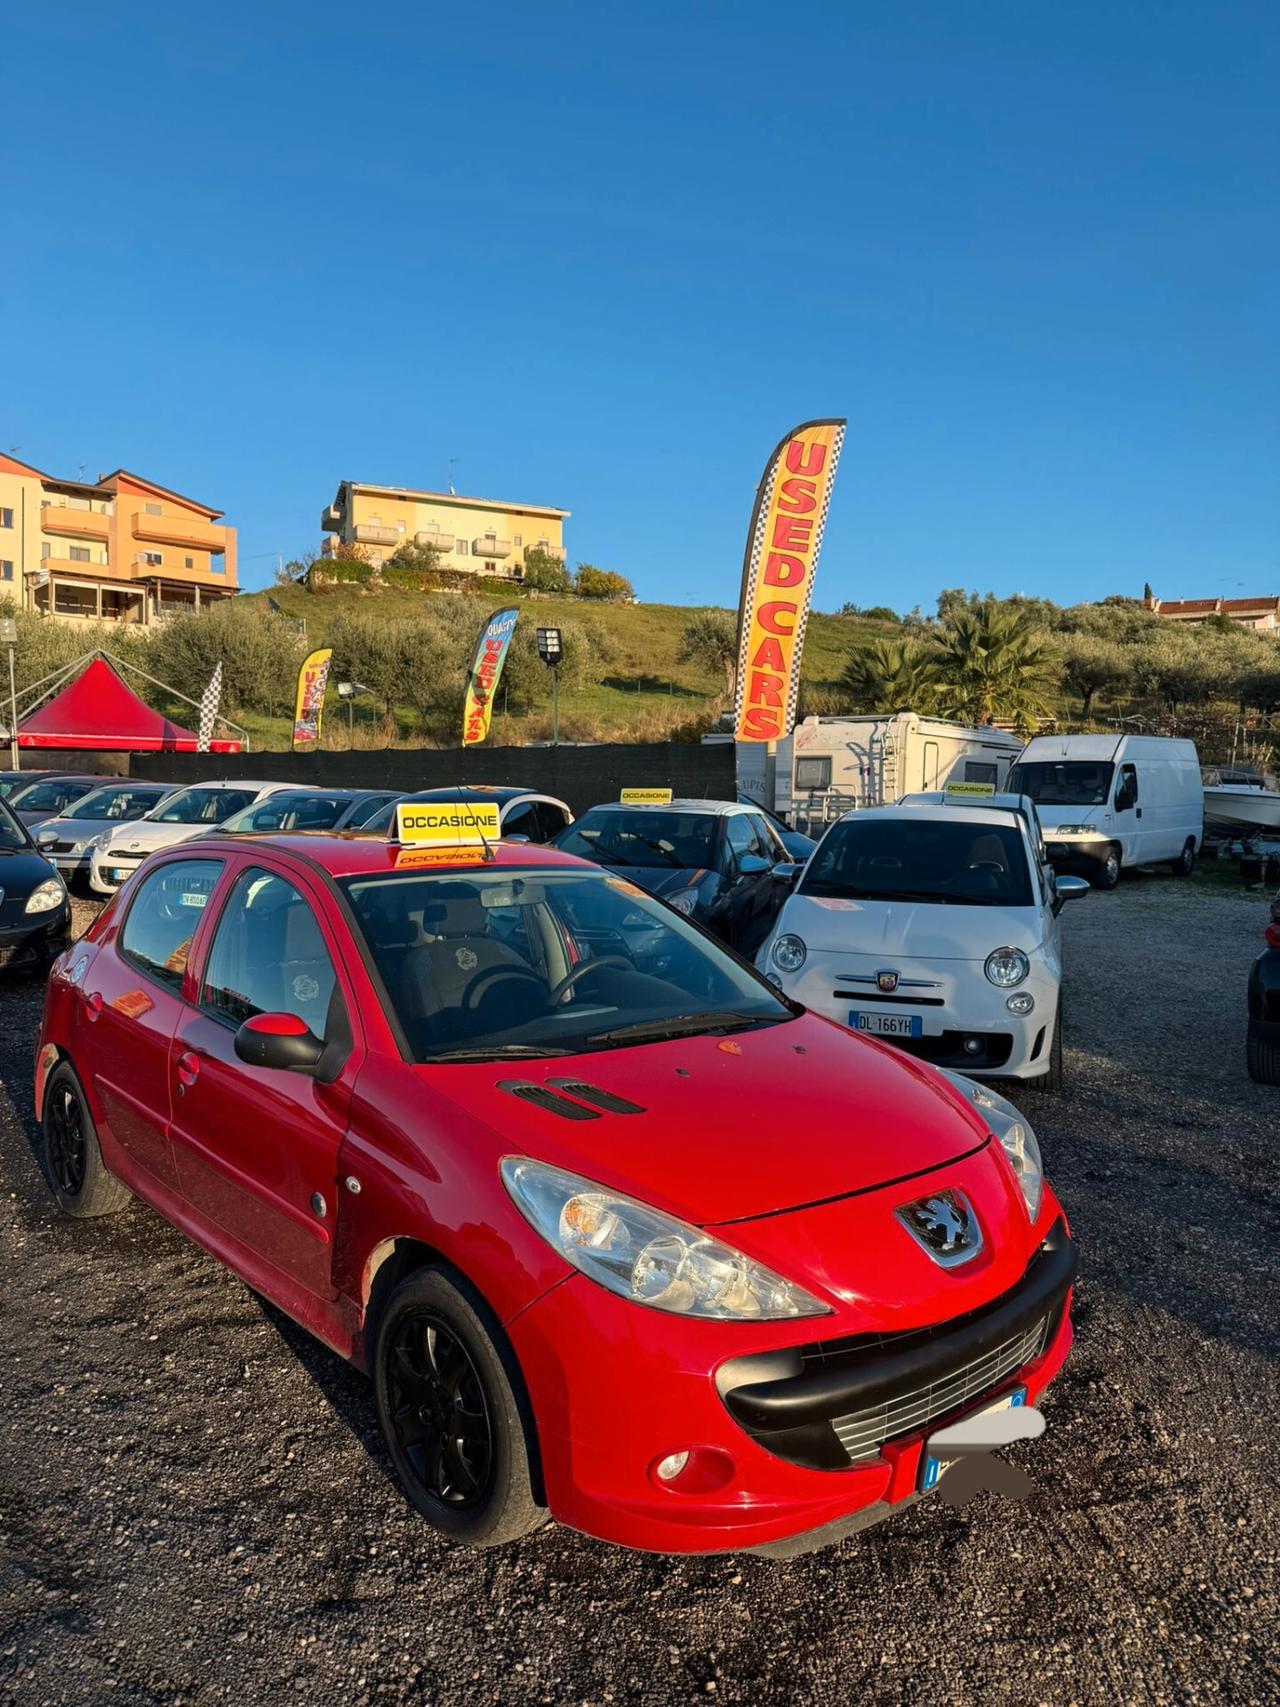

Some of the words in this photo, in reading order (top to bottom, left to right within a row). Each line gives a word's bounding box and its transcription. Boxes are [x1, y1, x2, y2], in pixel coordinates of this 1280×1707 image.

[763, 440, 827, 588] USED
[743, 601, 797, 740] CARS
[403, 815, 497, 829] OCCASIONE
